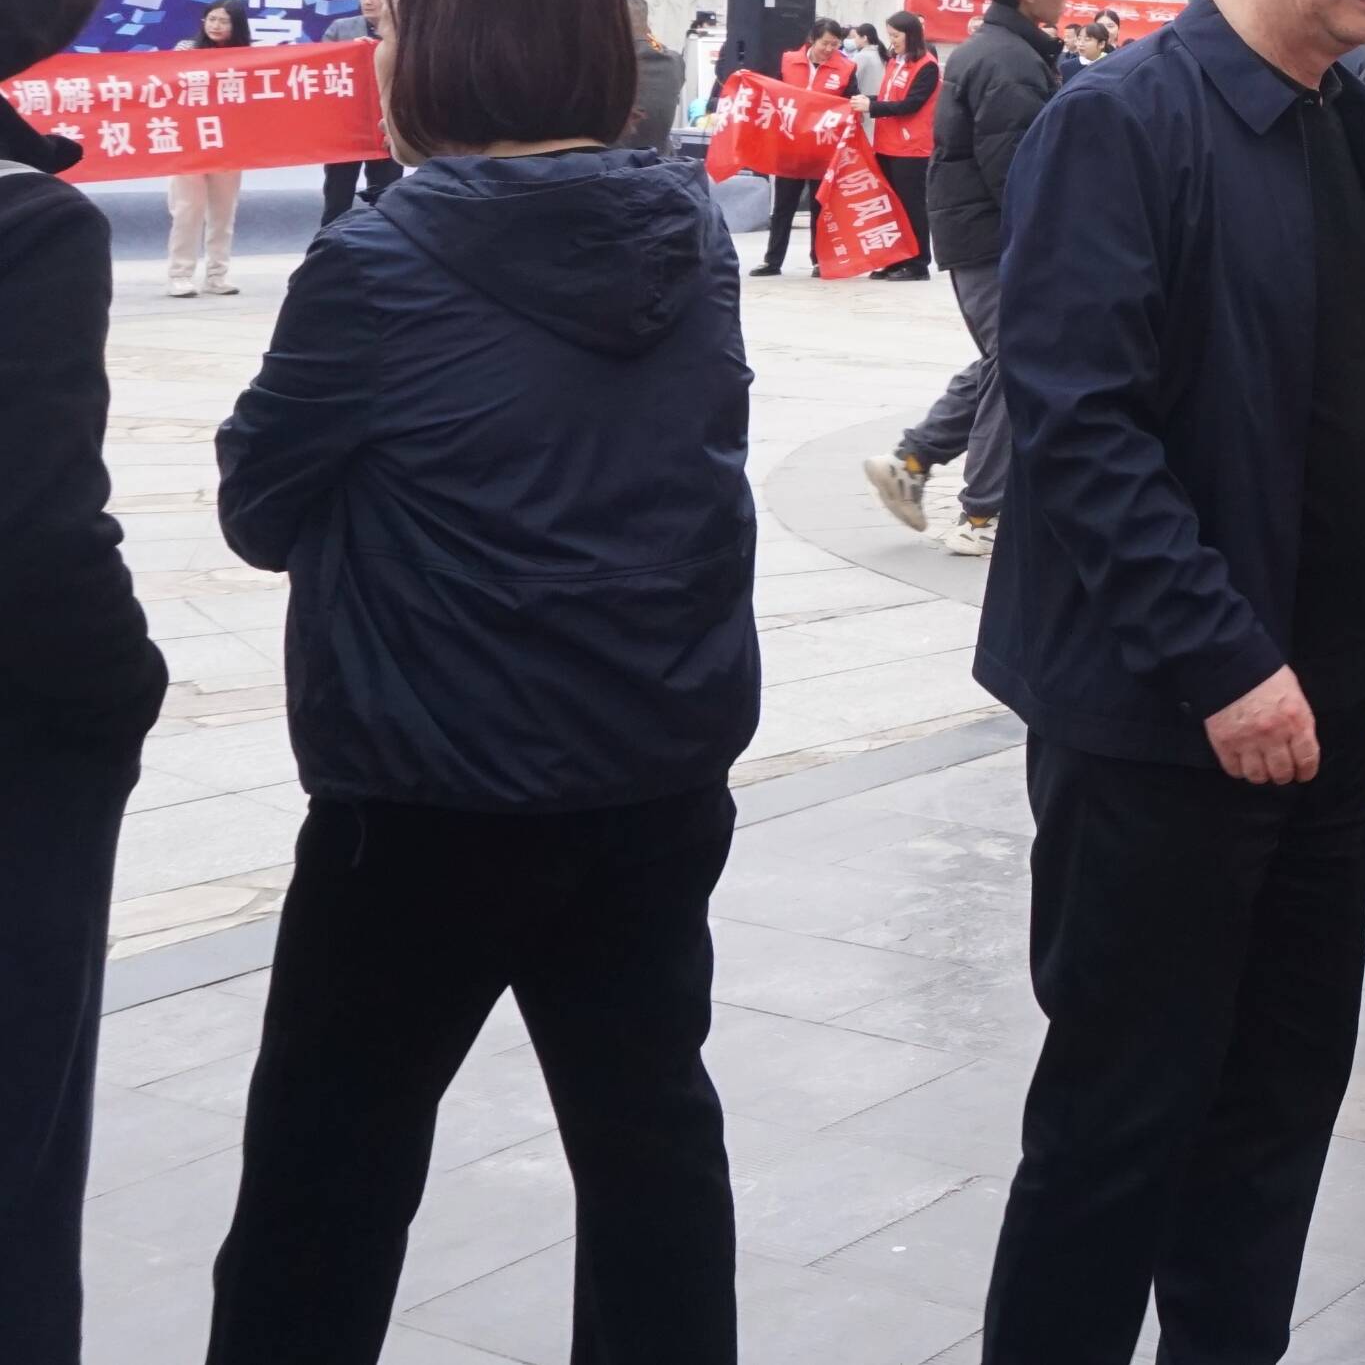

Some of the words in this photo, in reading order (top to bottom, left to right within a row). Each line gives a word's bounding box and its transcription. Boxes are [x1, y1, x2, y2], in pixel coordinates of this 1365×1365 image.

[0, 62, 355, 116] 调解中心渭南工作站
